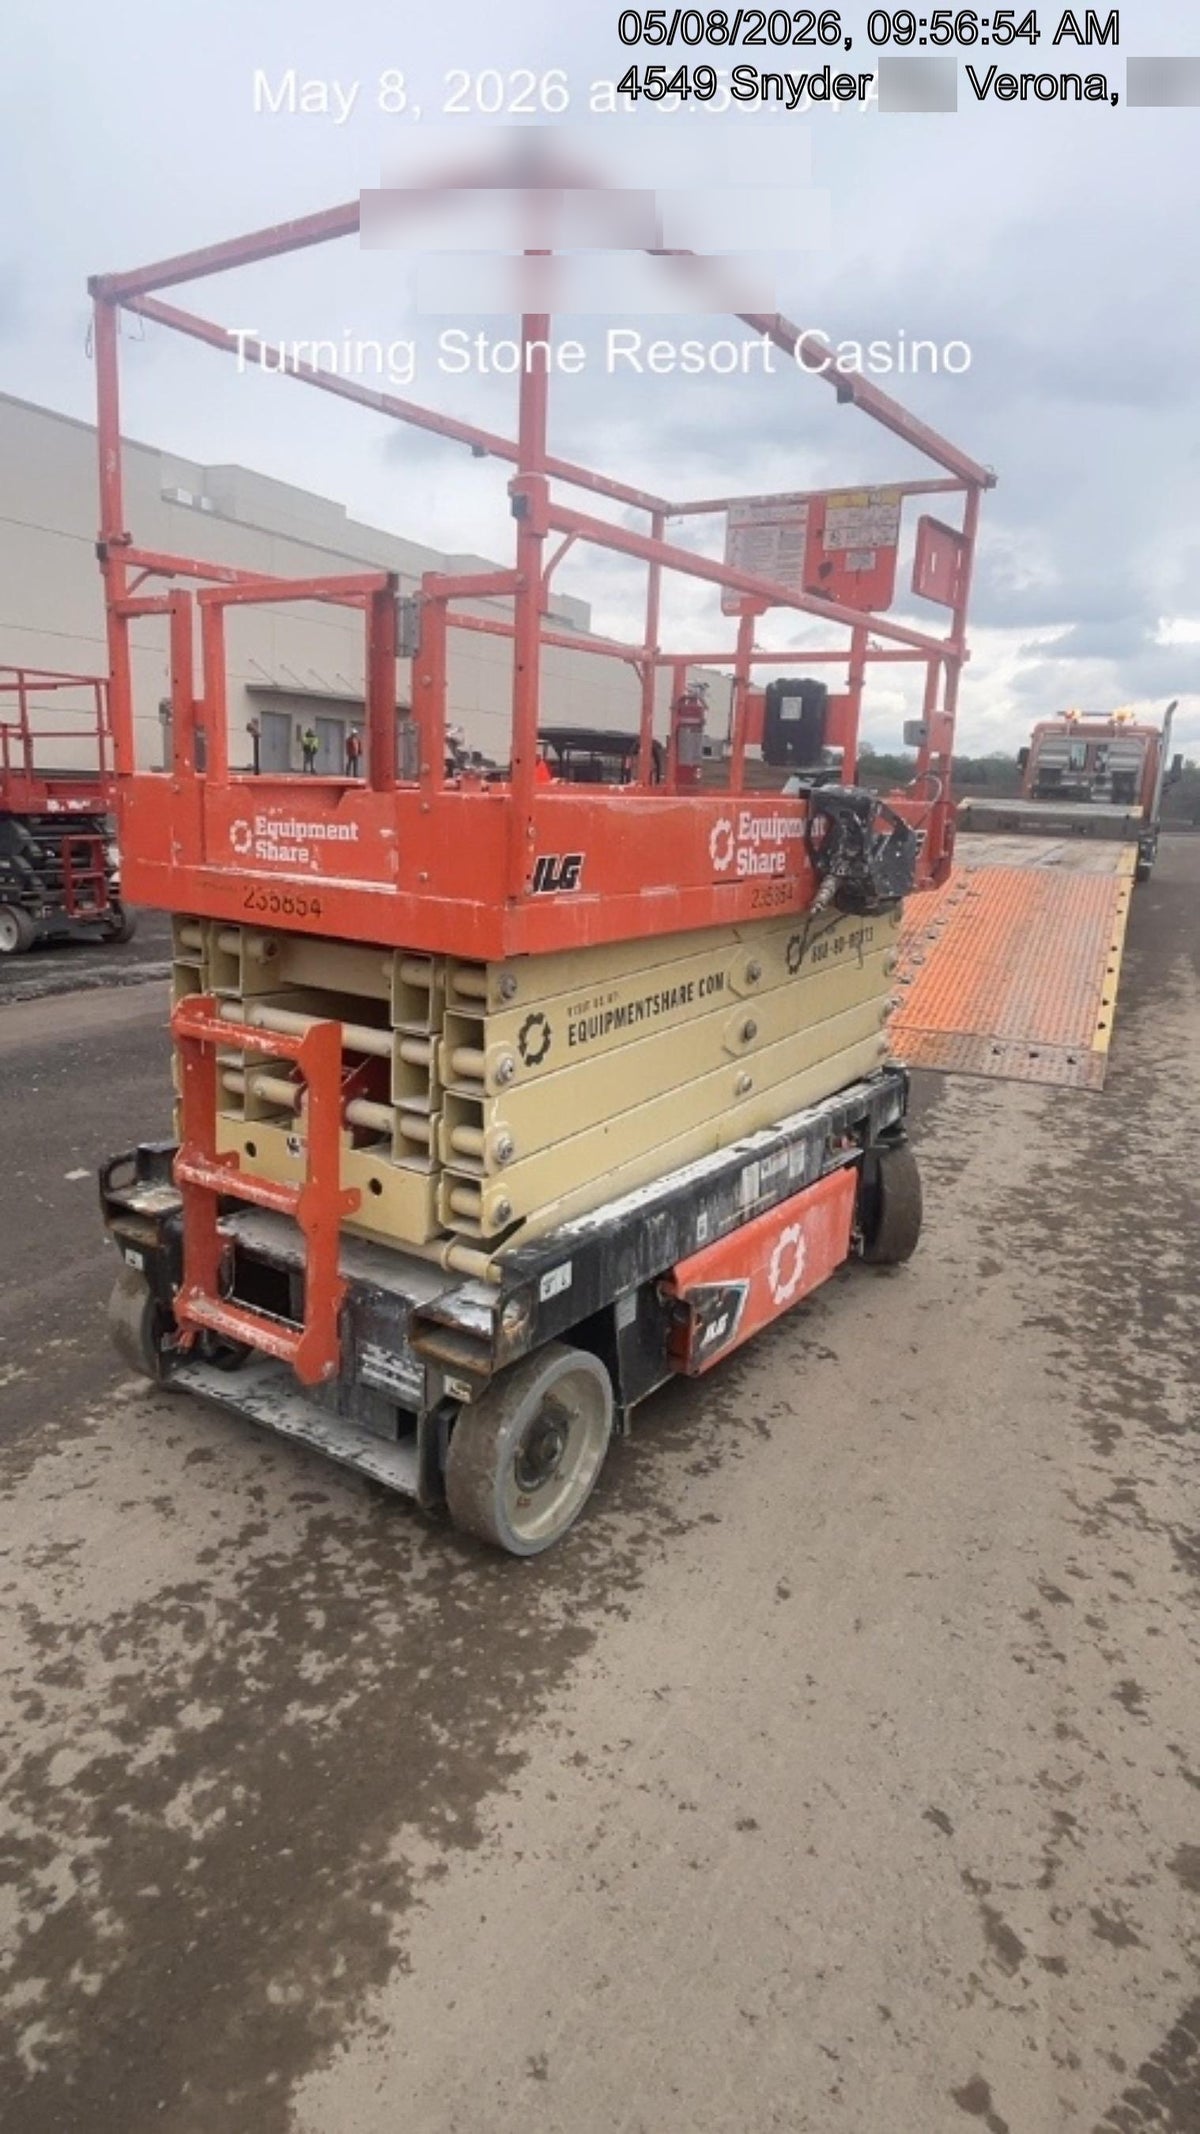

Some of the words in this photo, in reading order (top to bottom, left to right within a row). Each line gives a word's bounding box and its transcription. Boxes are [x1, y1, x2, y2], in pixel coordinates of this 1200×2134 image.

[255, 815, 360, 842] Equipment
[255, 839, 309, 863] Share
[736, 843, 786, 876] Share
[532, 852, 586, 896] JLG
